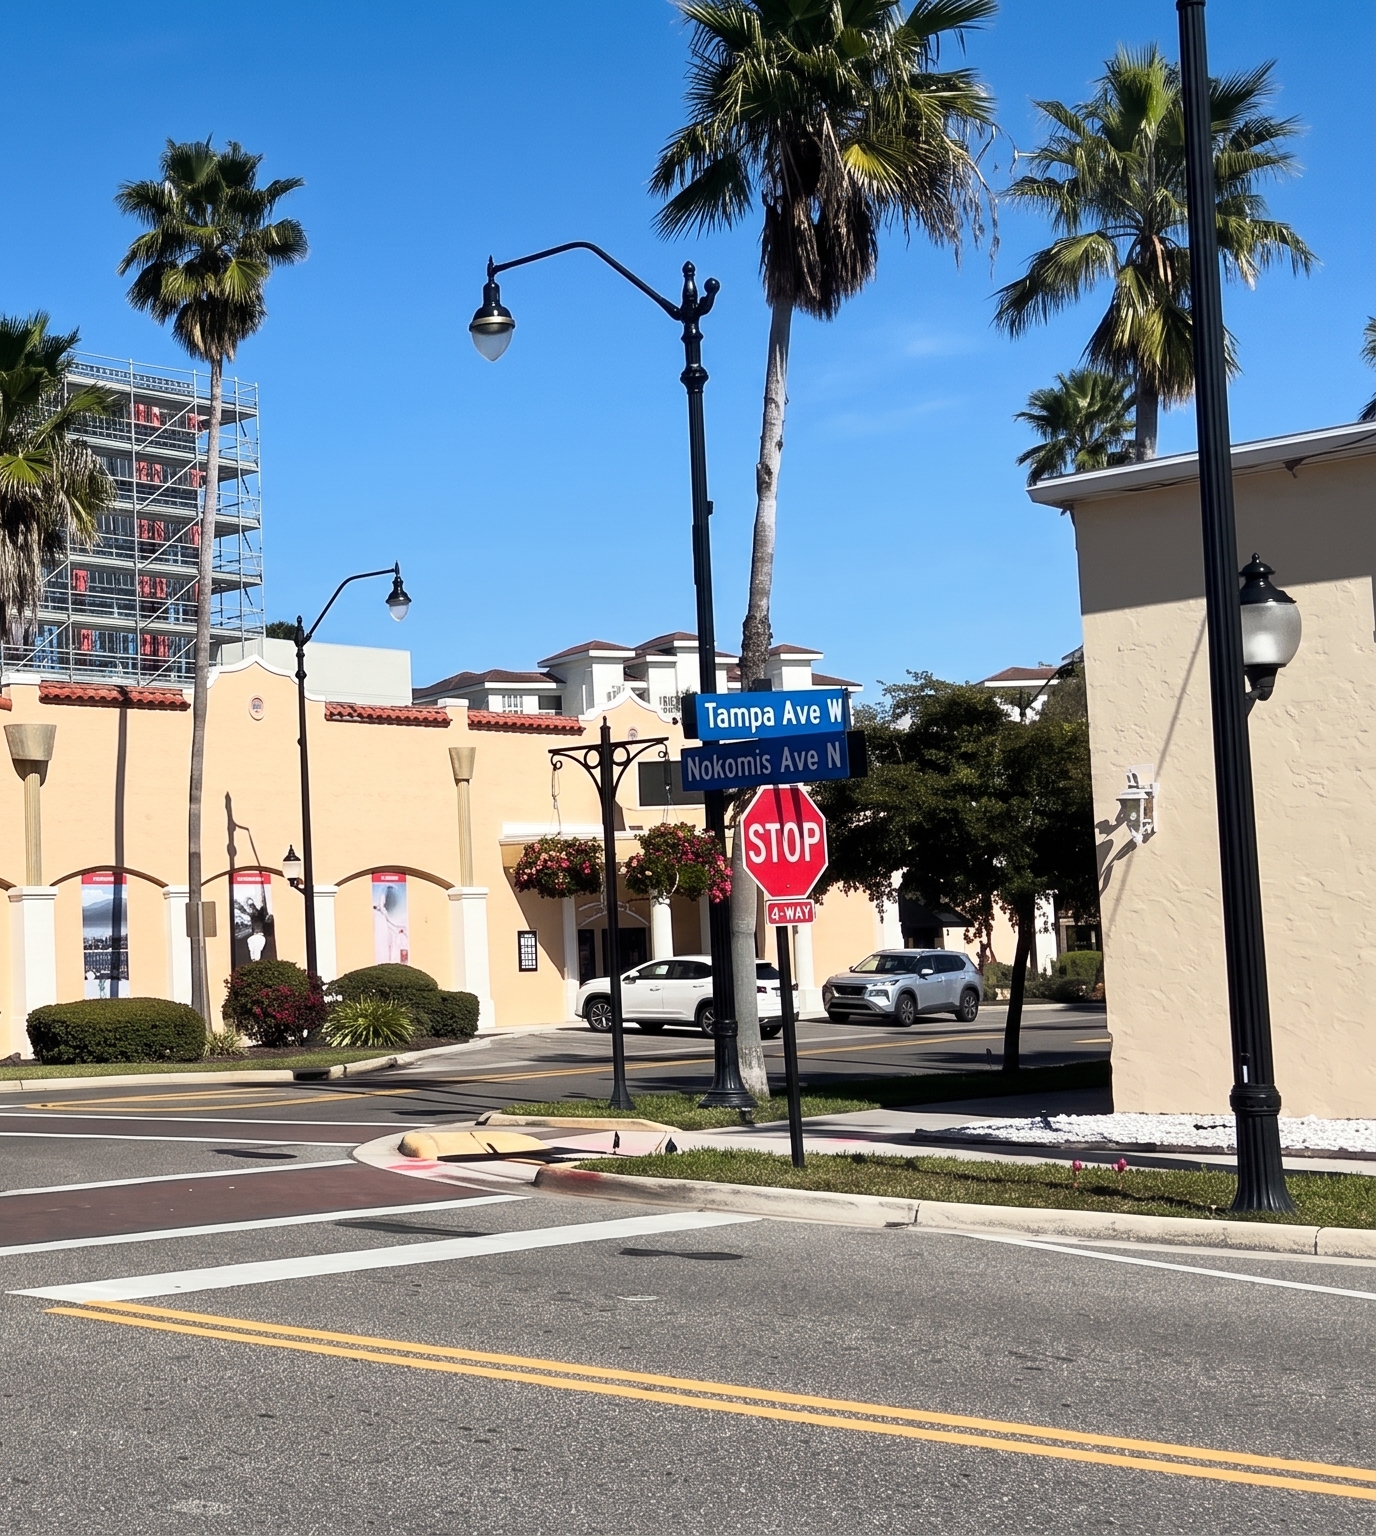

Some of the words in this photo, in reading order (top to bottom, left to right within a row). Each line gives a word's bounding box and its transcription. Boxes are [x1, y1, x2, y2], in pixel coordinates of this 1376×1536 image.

[704, 702, 775, 733] Tampa
[782, 700, 821, 725] Ave
[827, 698, 843, 723] W
[687, 749, 772, 782] Nokomis
[780, 746, 819, 773] Ave
[827, 742, 841, 769] N
[748, 821, 821, 864] STOP
[771, 905, 811, 921] 4-WAY
